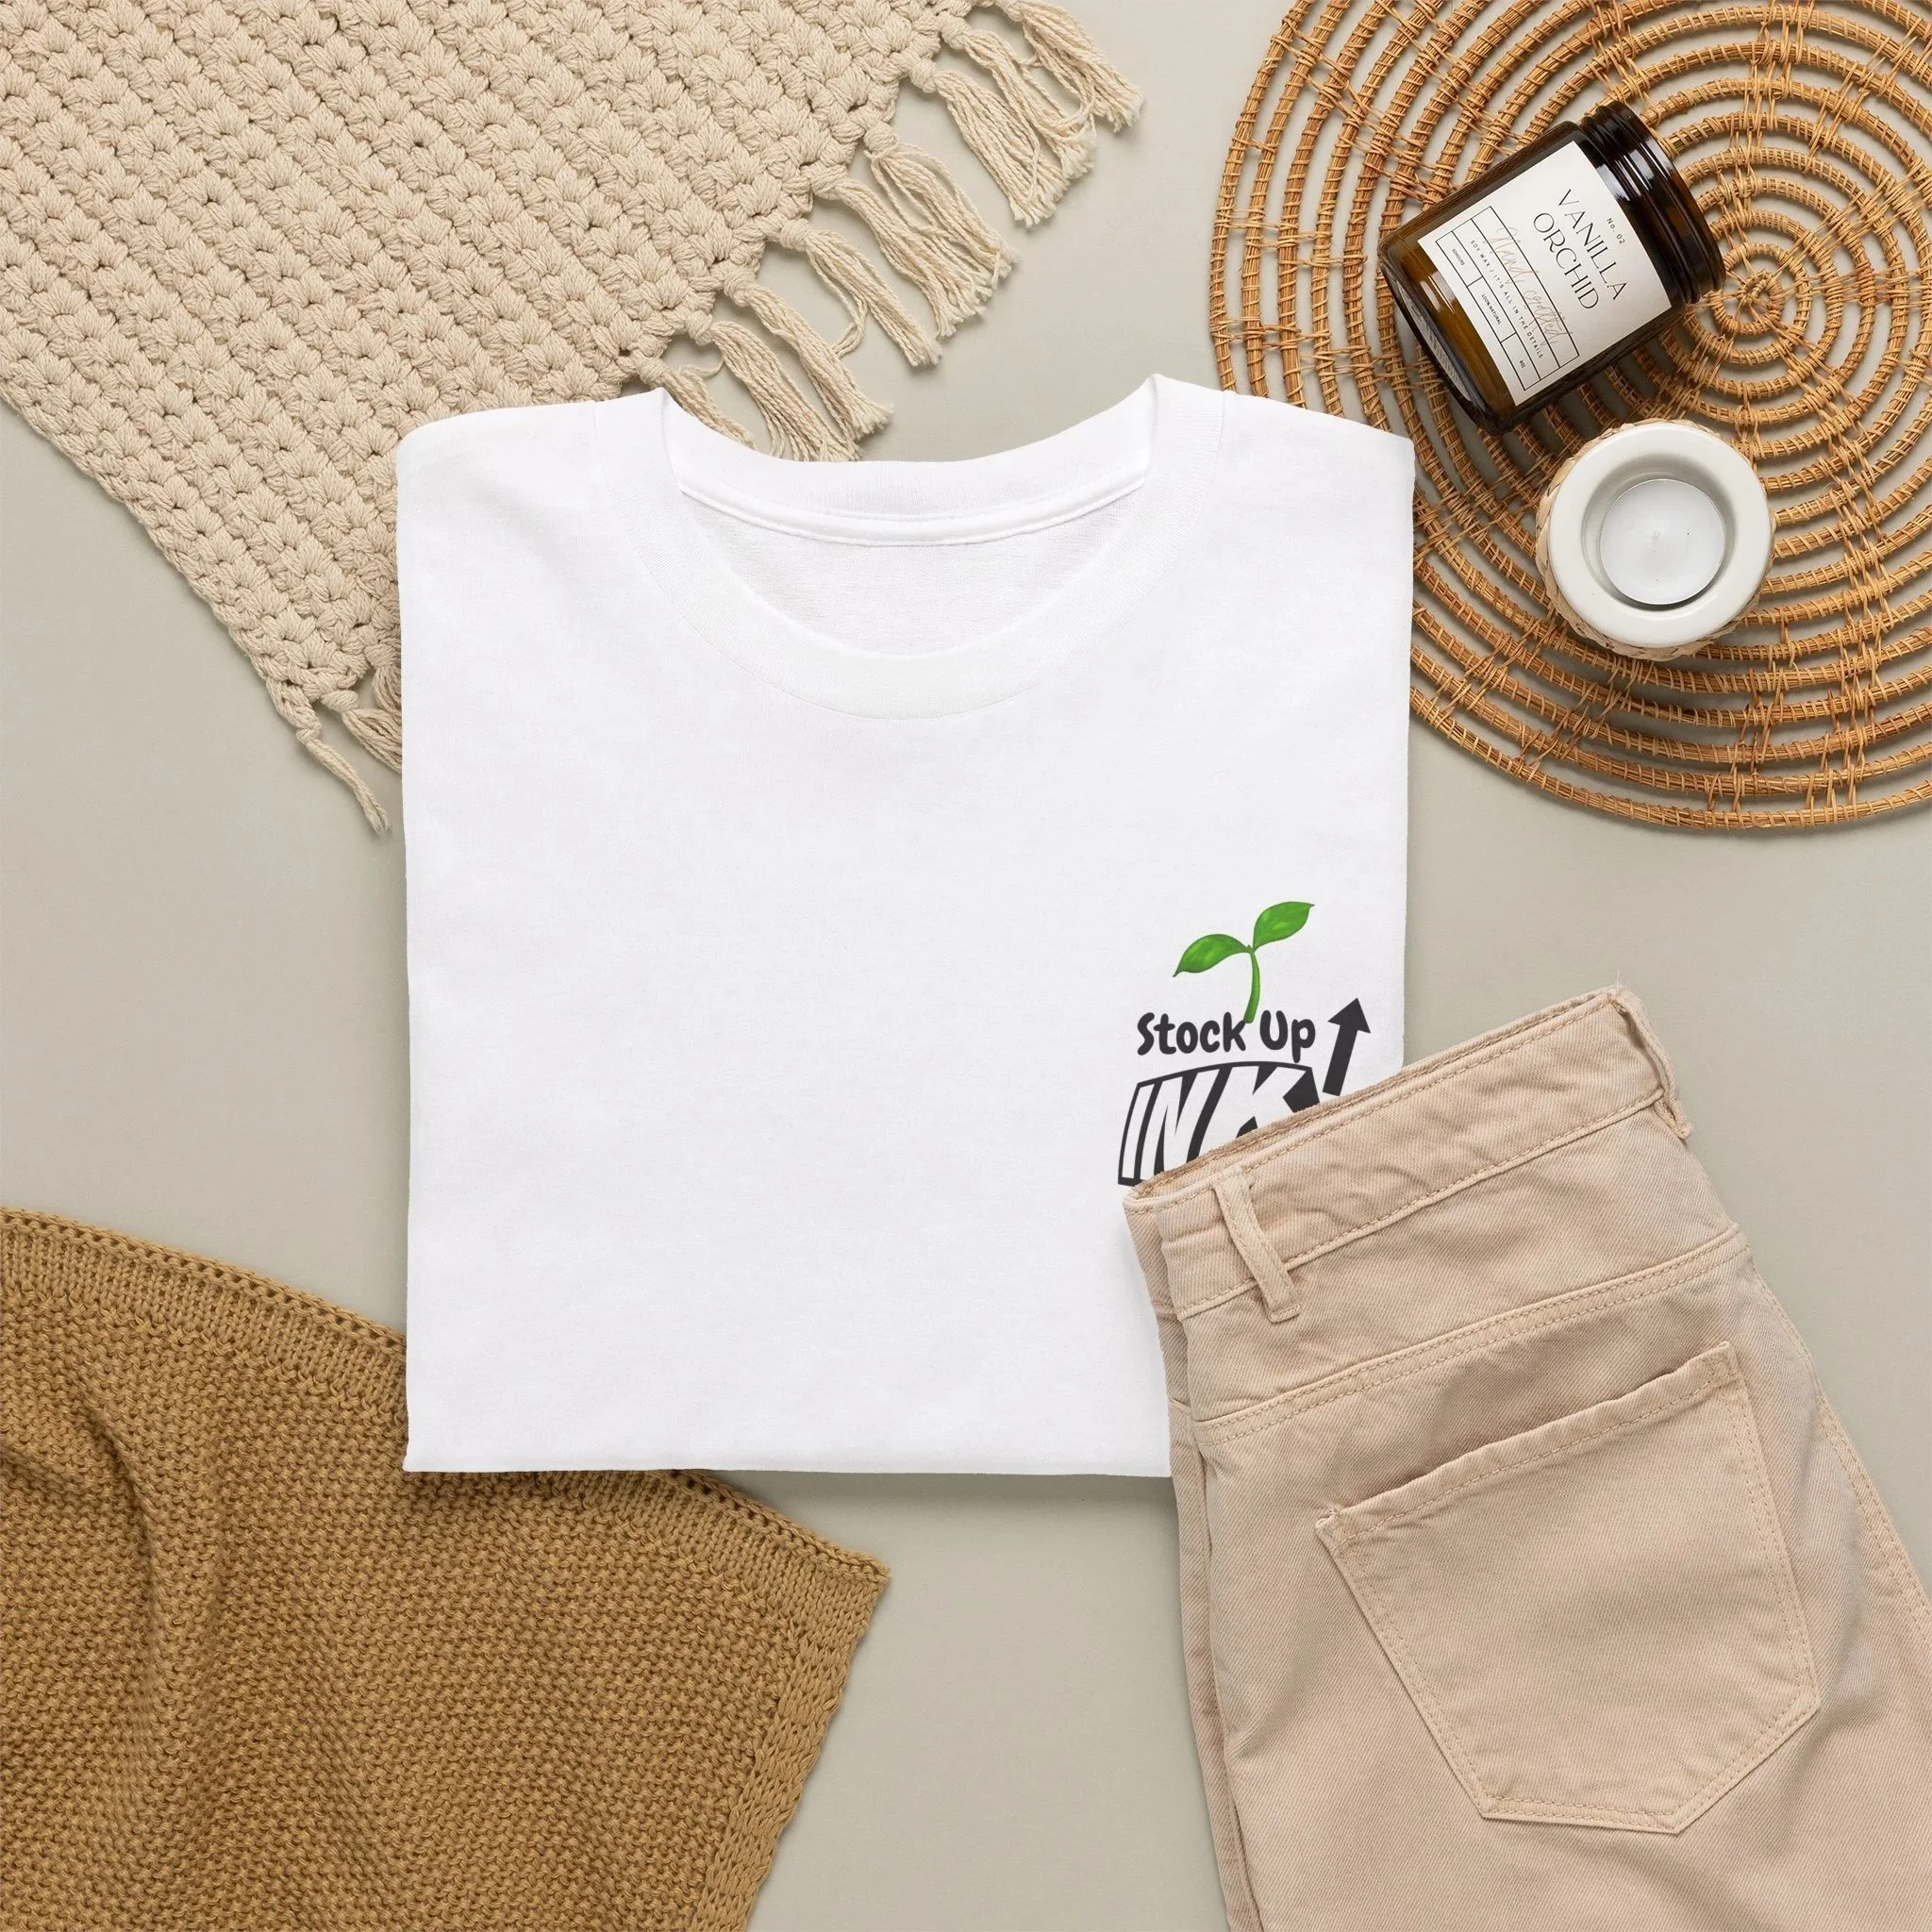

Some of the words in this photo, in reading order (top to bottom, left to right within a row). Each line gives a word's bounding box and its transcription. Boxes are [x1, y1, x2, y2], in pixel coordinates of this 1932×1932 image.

[1533, 212, 1600, 309] ORCHID
[1557, 188, 1627, 301] VANILLA
[1606, 217, 1616, 233] No.
[1616, 233, 1626, 245] 02
[1470, 240, 1481, 253] SOY
[1479, 253, 1491, 268] WAX
[1502, 291, 1514, 305] ALL
[1511, 305, 1520, 315] IN
[1518, 315, 1530, 330] THE
[1526, 331, 1544, 358] DETAILS
[1488, 305, 1502, 325] NATURAL
[1137, 1011, 1246, 1056] Stock
[1259, 1010, 1316, 1063] Up
